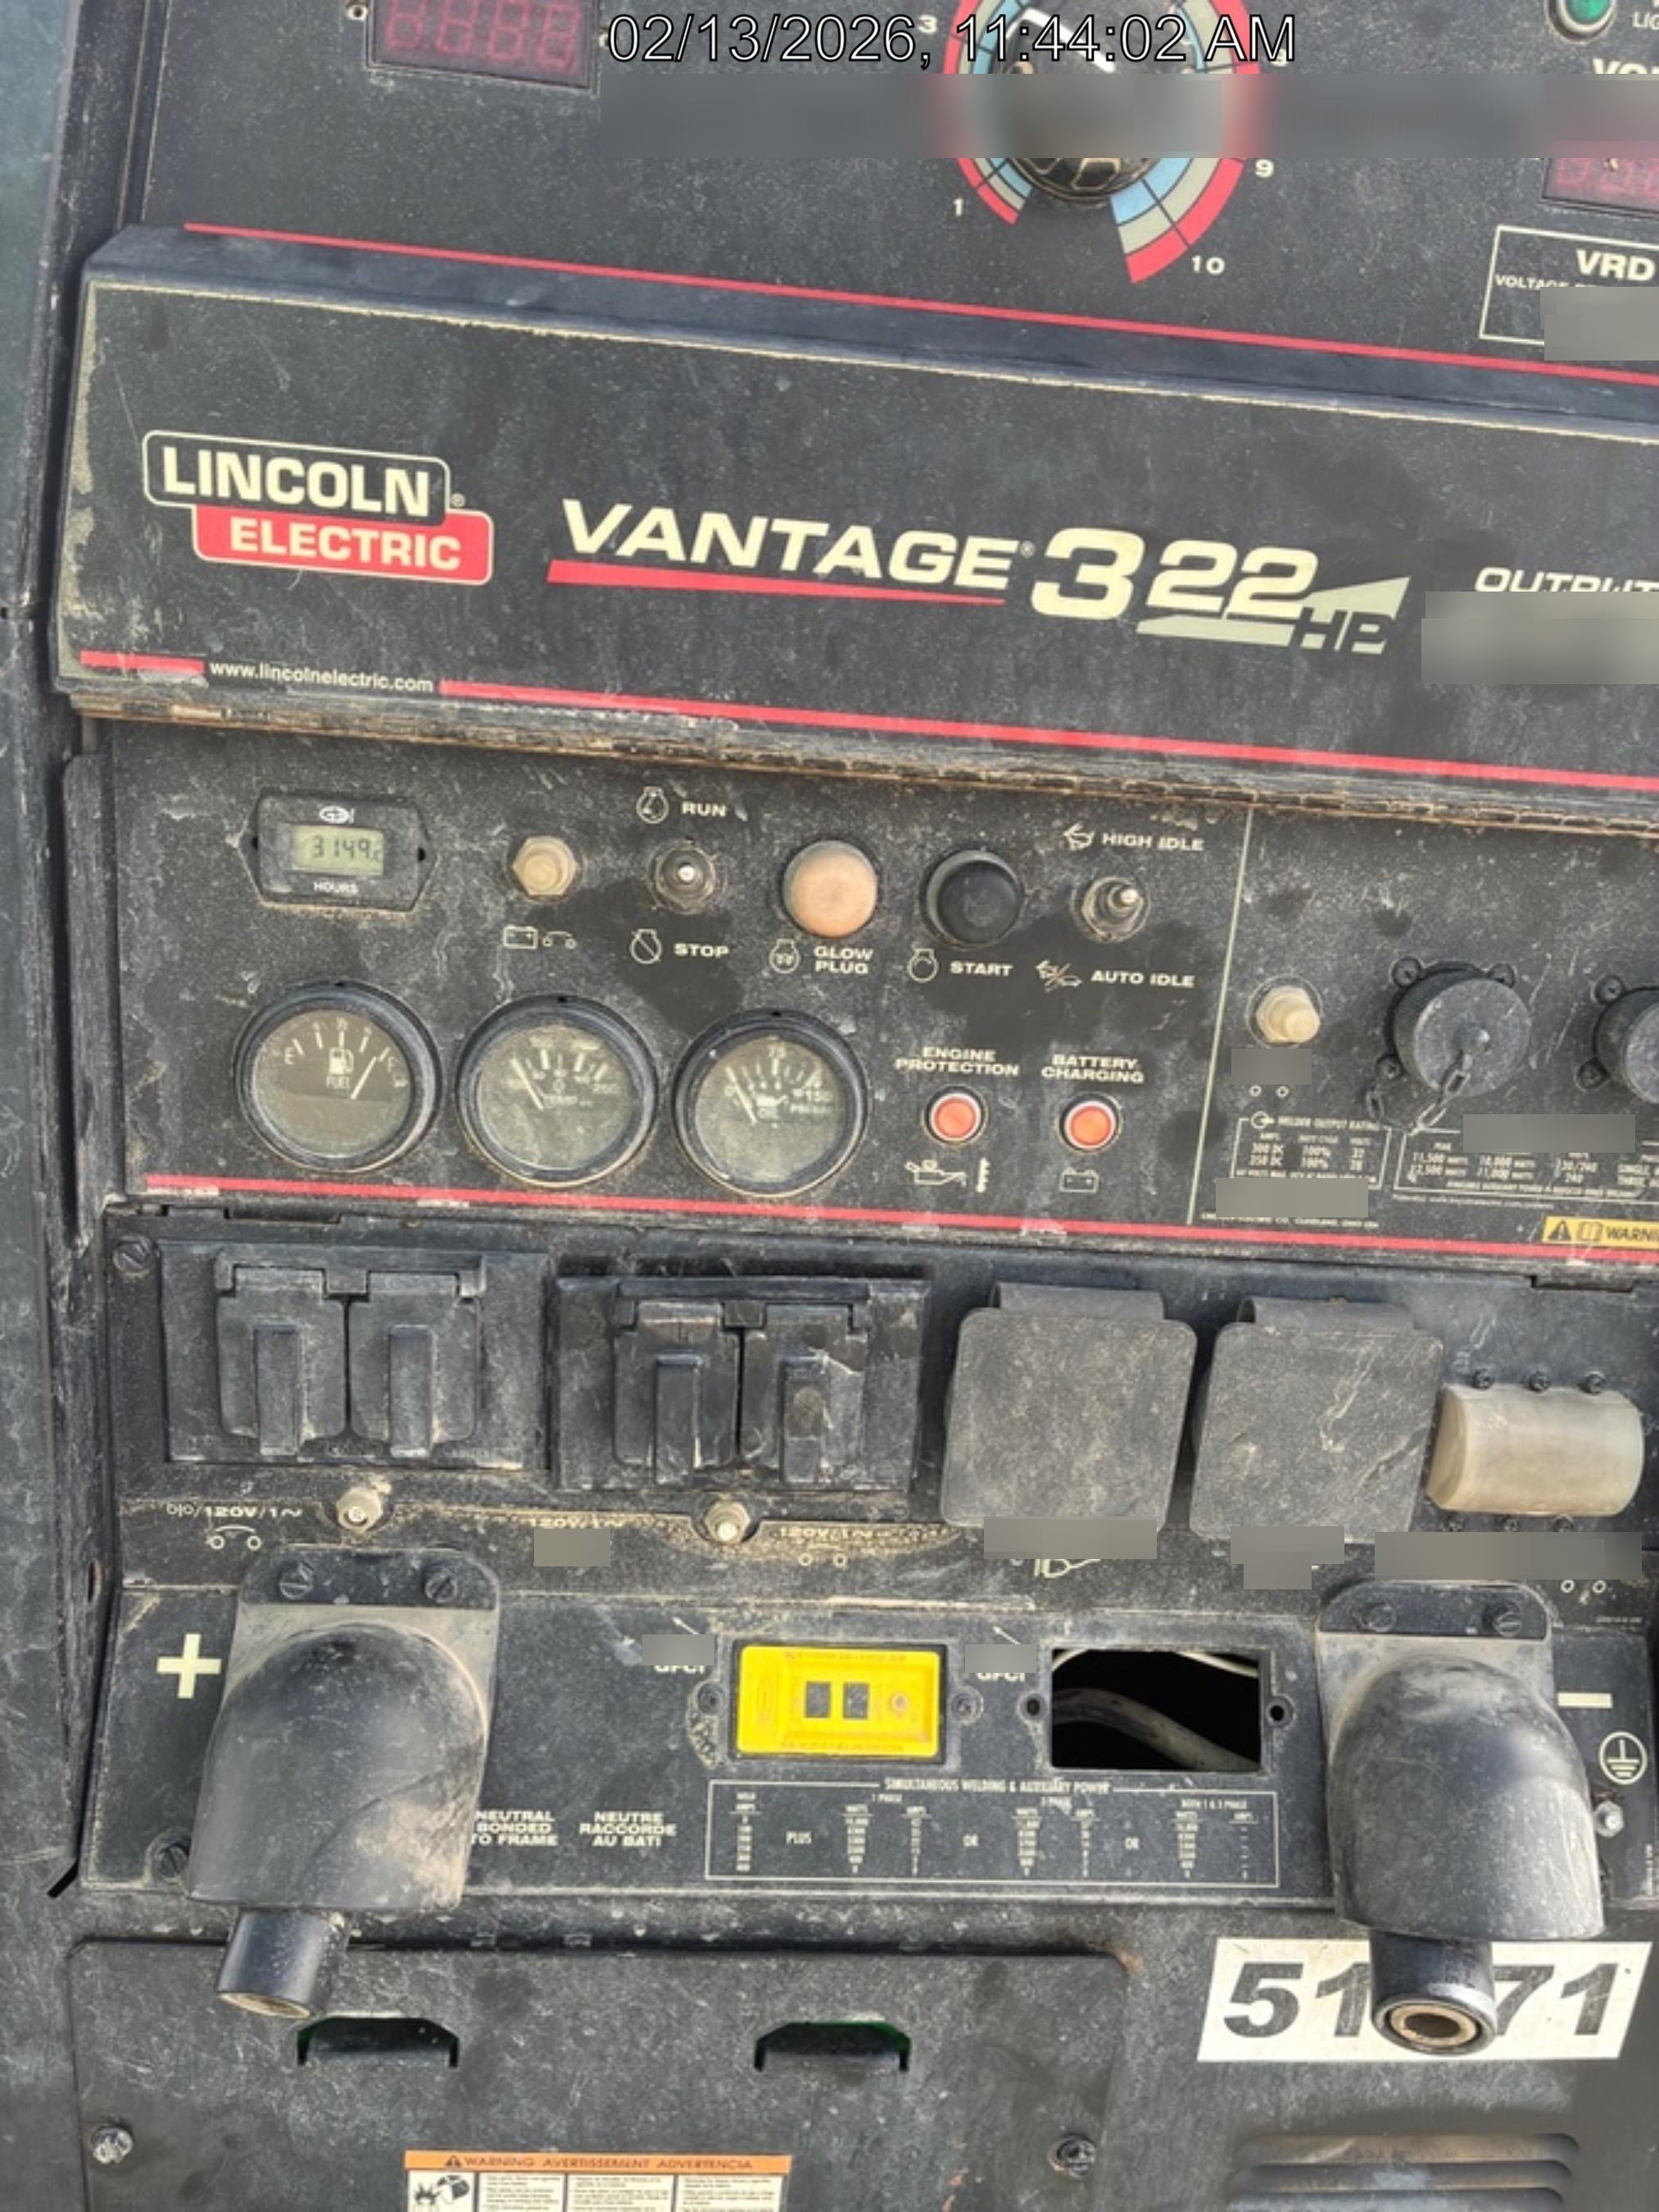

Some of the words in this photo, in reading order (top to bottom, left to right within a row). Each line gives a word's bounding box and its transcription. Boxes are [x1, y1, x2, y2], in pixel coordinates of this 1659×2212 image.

[918, 15, 938, 34] 3
[1255, 160, 1275, 179] 9
[953, 198, 964, 217] 1
[1192, 256, 1226, 275] 10
[1575, 248, 1656, 282] VRD
[163, 446, 430, 517] LINCOLN
[230, 516, 461, 571] ELECTRIC
[562, 498, 1019, 589] VANTAGE
[1031, 527, 1318, 621] 322
[210, 660, 434, 693] www.lincolnelectric.com
[682, 801, 727, 817] RUN
[1101, 832, 1153, 849] HIGH
[1158, 836, 1204, 851] IDLE
[313, 881, 358, 895] HOURS
[674, 942, 730, 959] STOP
[814, 945, 873, 962] GLOW
[815, 960, 869, 974] PLUG
[950, 960, 1013, 977] START
[1090, 969, 1144, 984] AUTO
[1150, 972, 1195, 989] IDLE
[284, 1046, 294, 1065] E
[922, 1046, 996, 1063] ENGINE
[1053, 1054, 1139, 1071] BATTERY
[388, 1056, 398, 1072] F
[896, 1058, 1020, 1077] PROTECTION
[1041, 1066, 1144, 1084] CHARGING
[476, 1811, 555, 1822] NEUTRAL
[594, 1811, 664, 1823] NEUTRE
[476, 1822, 552, 1834] BONDED
[498, 1834, 559, 1847] FRAME
[592, 1834, 616, 1847] AU
[786, 1831, 813, 1844] PLUS
[1223, 1962, 1619, 2038] 5171
[465, 2156, 535, 2168] WARNING
[542, 2157, 650, 2169] AVERTISSEMENT
[657, 2160, 753, 2170] ADVERTENCIA
